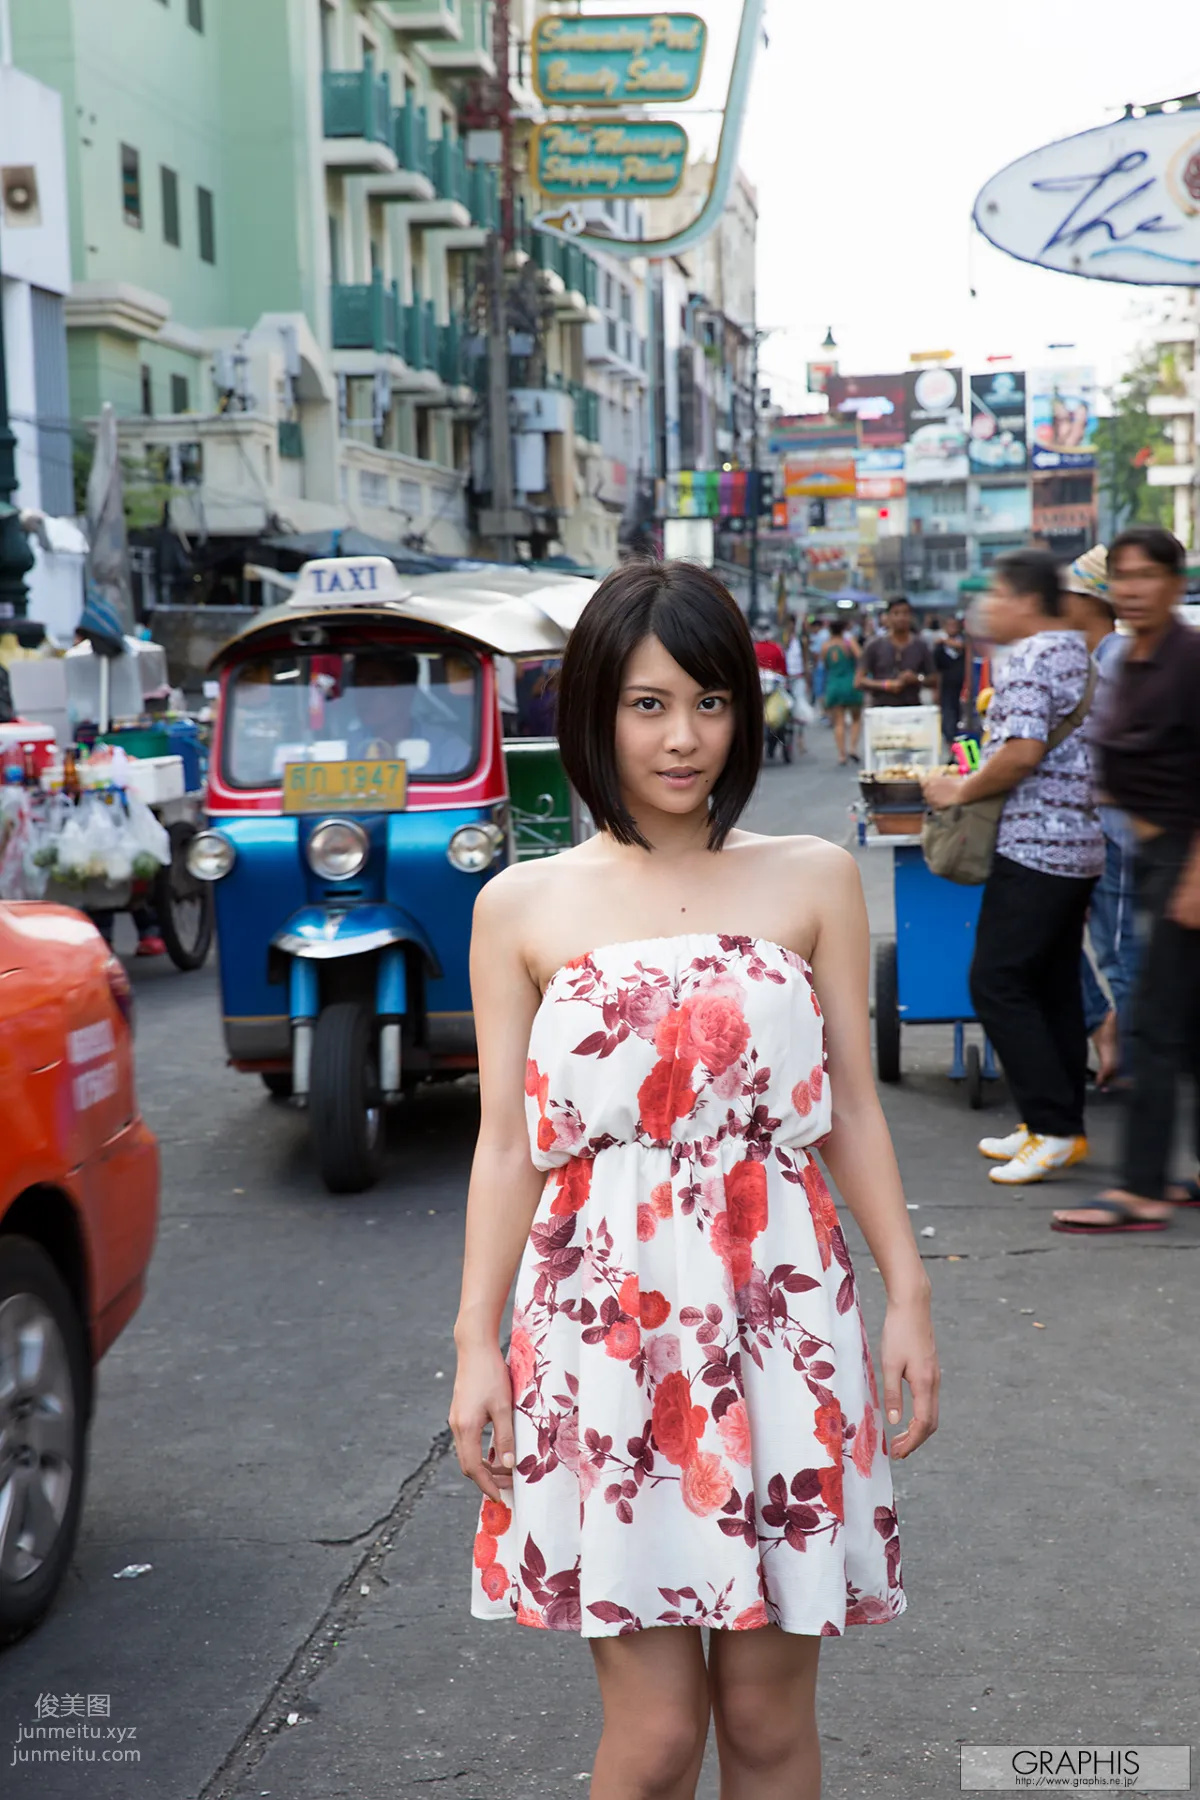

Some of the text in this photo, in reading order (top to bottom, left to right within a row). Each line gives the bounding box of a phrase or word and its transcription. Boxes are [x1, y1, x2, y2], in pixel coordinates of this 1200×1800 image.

[547, 58, 688, 97] Beauty Salon
[543, 126, 591, 155] Thai
[310, 565, 379, 593] TAXI
[340, 763, 401, 791] 1947
